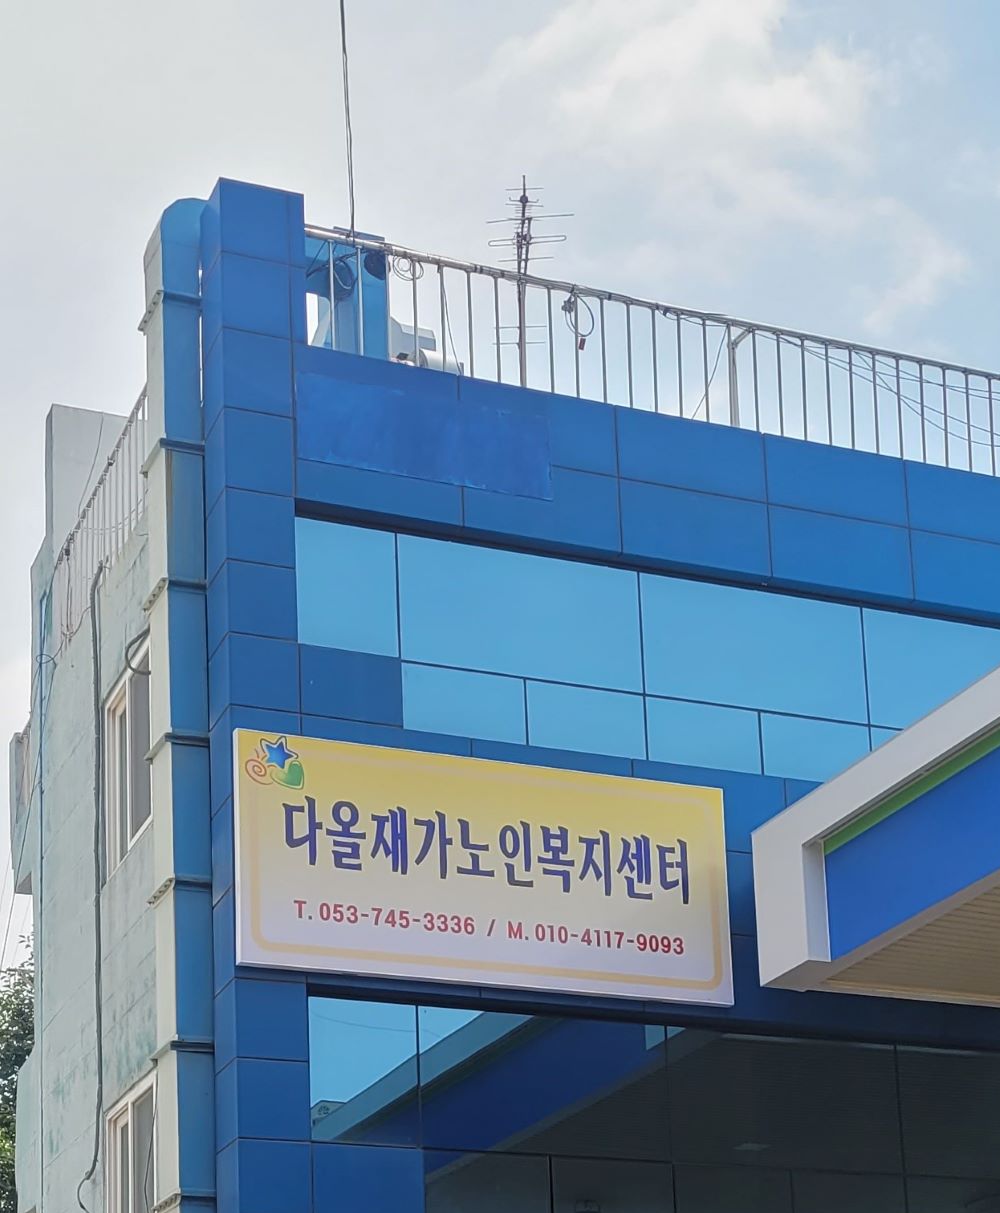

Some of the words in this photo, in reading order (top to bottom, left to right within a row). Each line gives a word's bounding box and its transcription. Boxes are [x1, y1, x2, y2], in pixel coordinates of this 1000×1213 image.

[281, 795, 690, 905] 다올재가노인복지센터
[319, 902, 475, 936] 053-745-3336
[534, 923, 685, 956] 010-4117-9093
